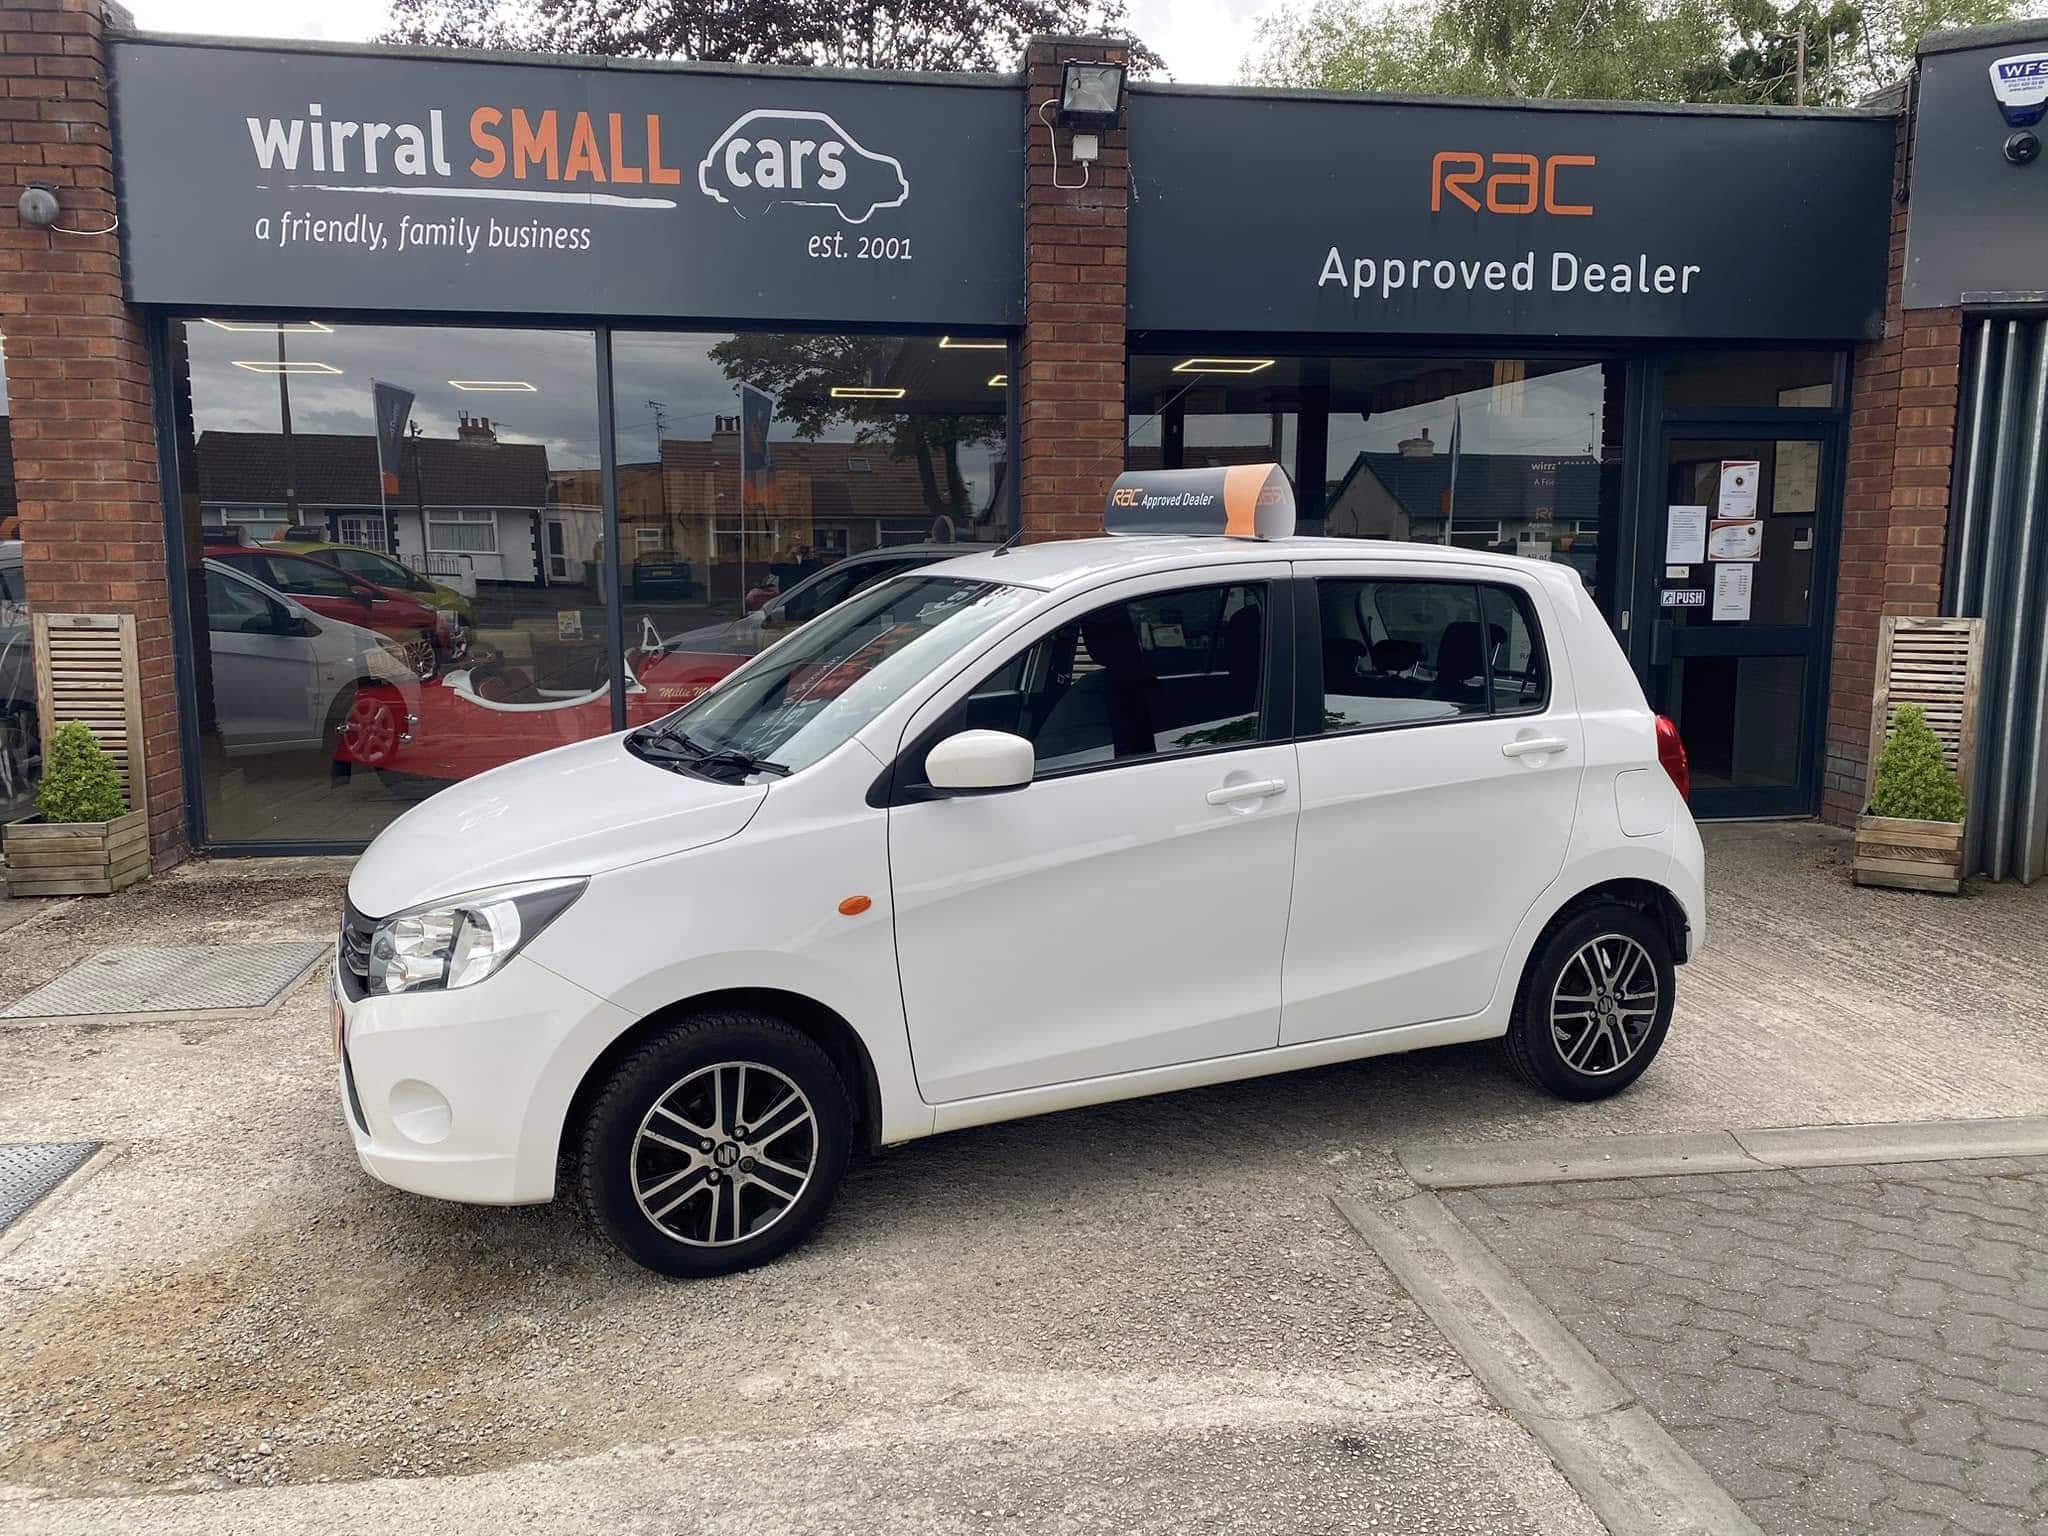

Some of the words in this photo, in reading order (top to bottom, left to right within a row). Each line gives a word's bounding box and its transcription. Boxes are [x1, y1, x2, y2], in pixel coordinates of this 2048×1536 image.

[246, 103, 451, 177] wirral
[469, 106, 681, 185] SMALL
[725, 137, 847, 190] cars
[254, 217, 270, 240] a
[279, 211, 390, 250] friendly,
[398, 215, 480, 253] family
[488, 218, 591, 250] business
[808, 231, 848, 259] est.
[857, 236, 912, 260] 2001
[1318, 246, 1535, 299] Approved
[1551, 252, 1701, 294] Dealer
[1141, 492, 1182, 509] Approved
[1182, 493, 1214, 506] Dealer
[1677, 592, 1702, 604] PUSH
[658, 687, 690, 698] Millie
